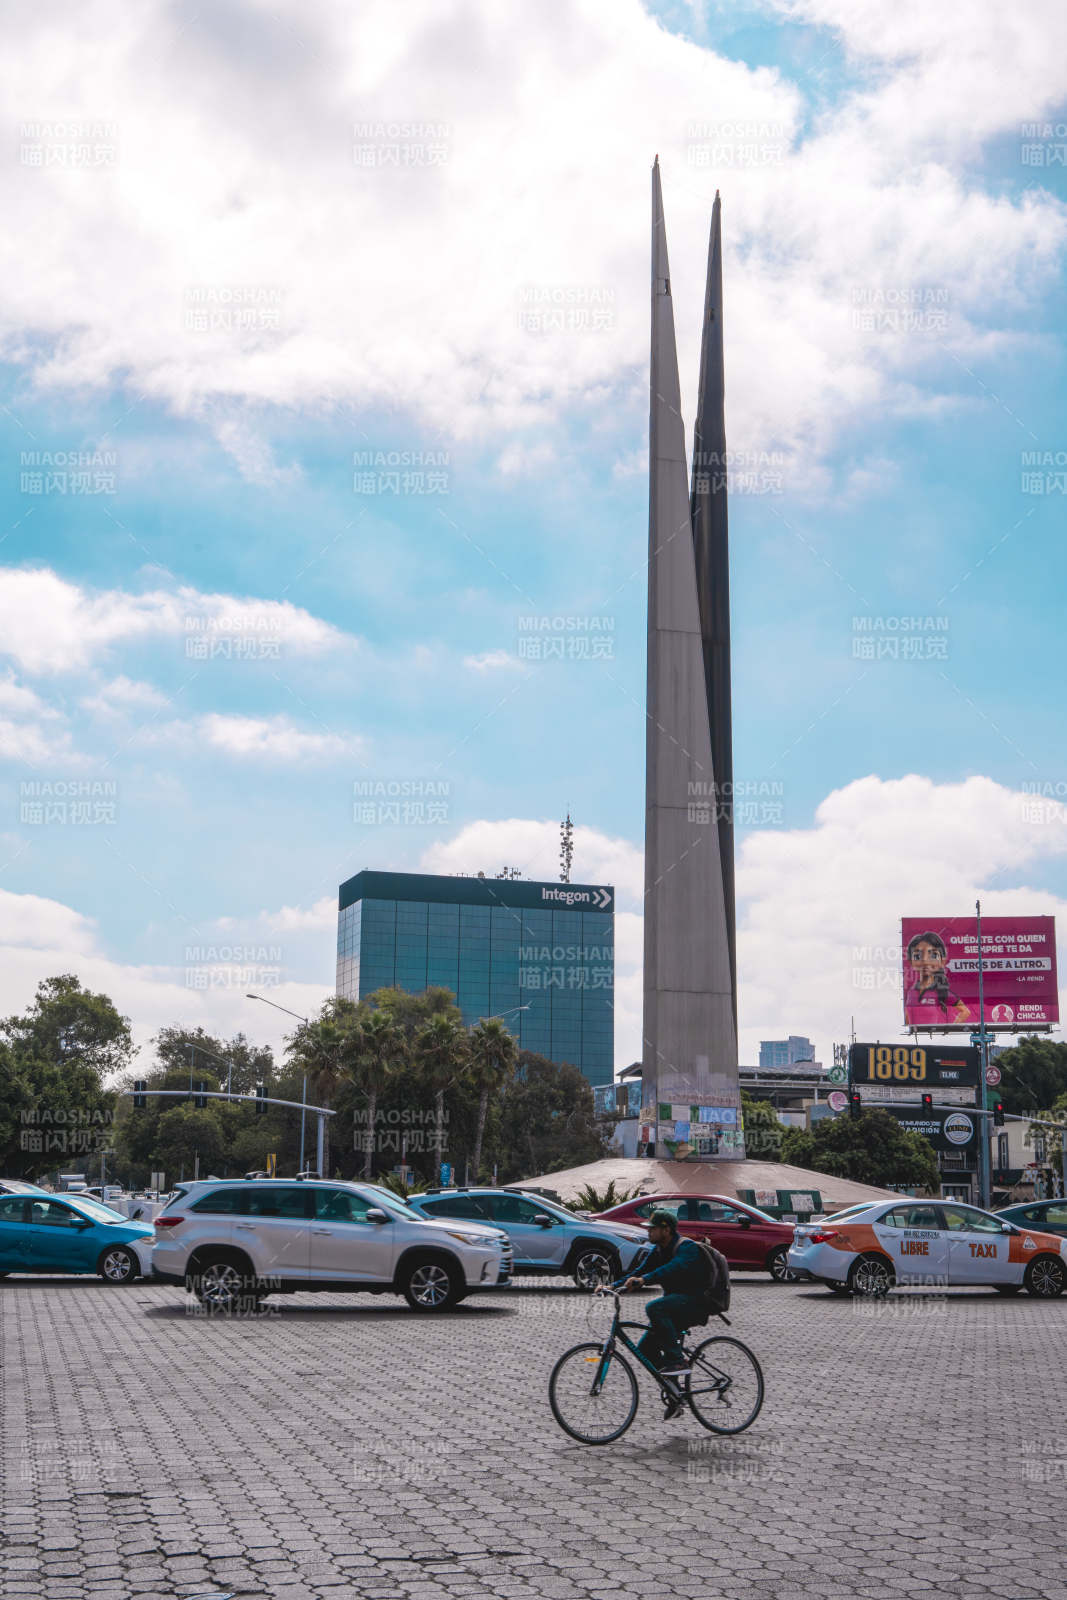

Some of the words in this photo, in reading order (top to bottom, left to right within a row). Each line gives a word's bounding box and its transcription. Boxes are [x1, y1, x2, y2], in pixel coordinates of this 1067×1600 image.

[542, 888, 590, 905] Integon
[1017, 935, 1046, 943] QUIEN
[1007, 945, 1018, 953] TE
[1019, 945, 1032, 953] DA
[954, 962, 988, 970] LITROS
[991, 961, 1003, 969] DE
[868, 1047, 926, 1080] 1889
[900, 1240, 929, 1256] LIBRE
[968, 1243, 997, 1259] TAXI
